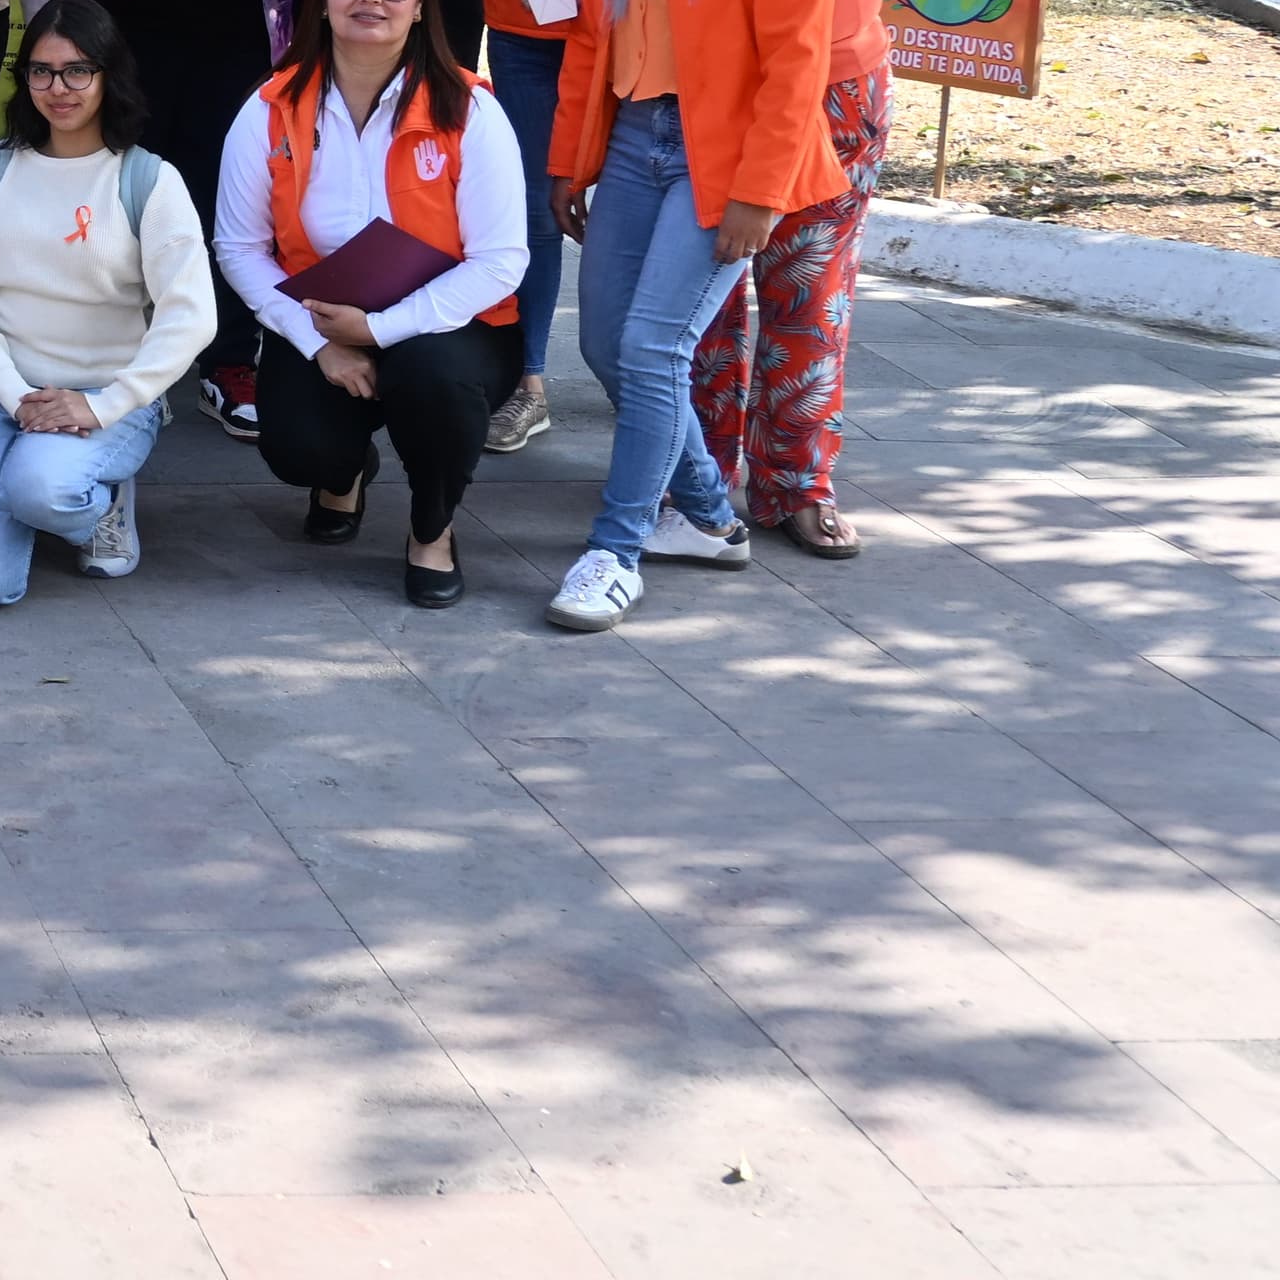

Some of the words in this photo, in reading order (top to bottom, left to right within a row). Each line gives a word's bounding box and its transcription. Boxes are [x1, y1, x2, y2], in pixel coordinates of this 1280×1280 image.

[903, 28, 1014, 61] DESTRUYAS
[890, 49, 922, 70] QUE
[928, 55, 947, 72] TE
[952, 58, 977, 78] DA
[981, 63, 1023, 85] VIDA
